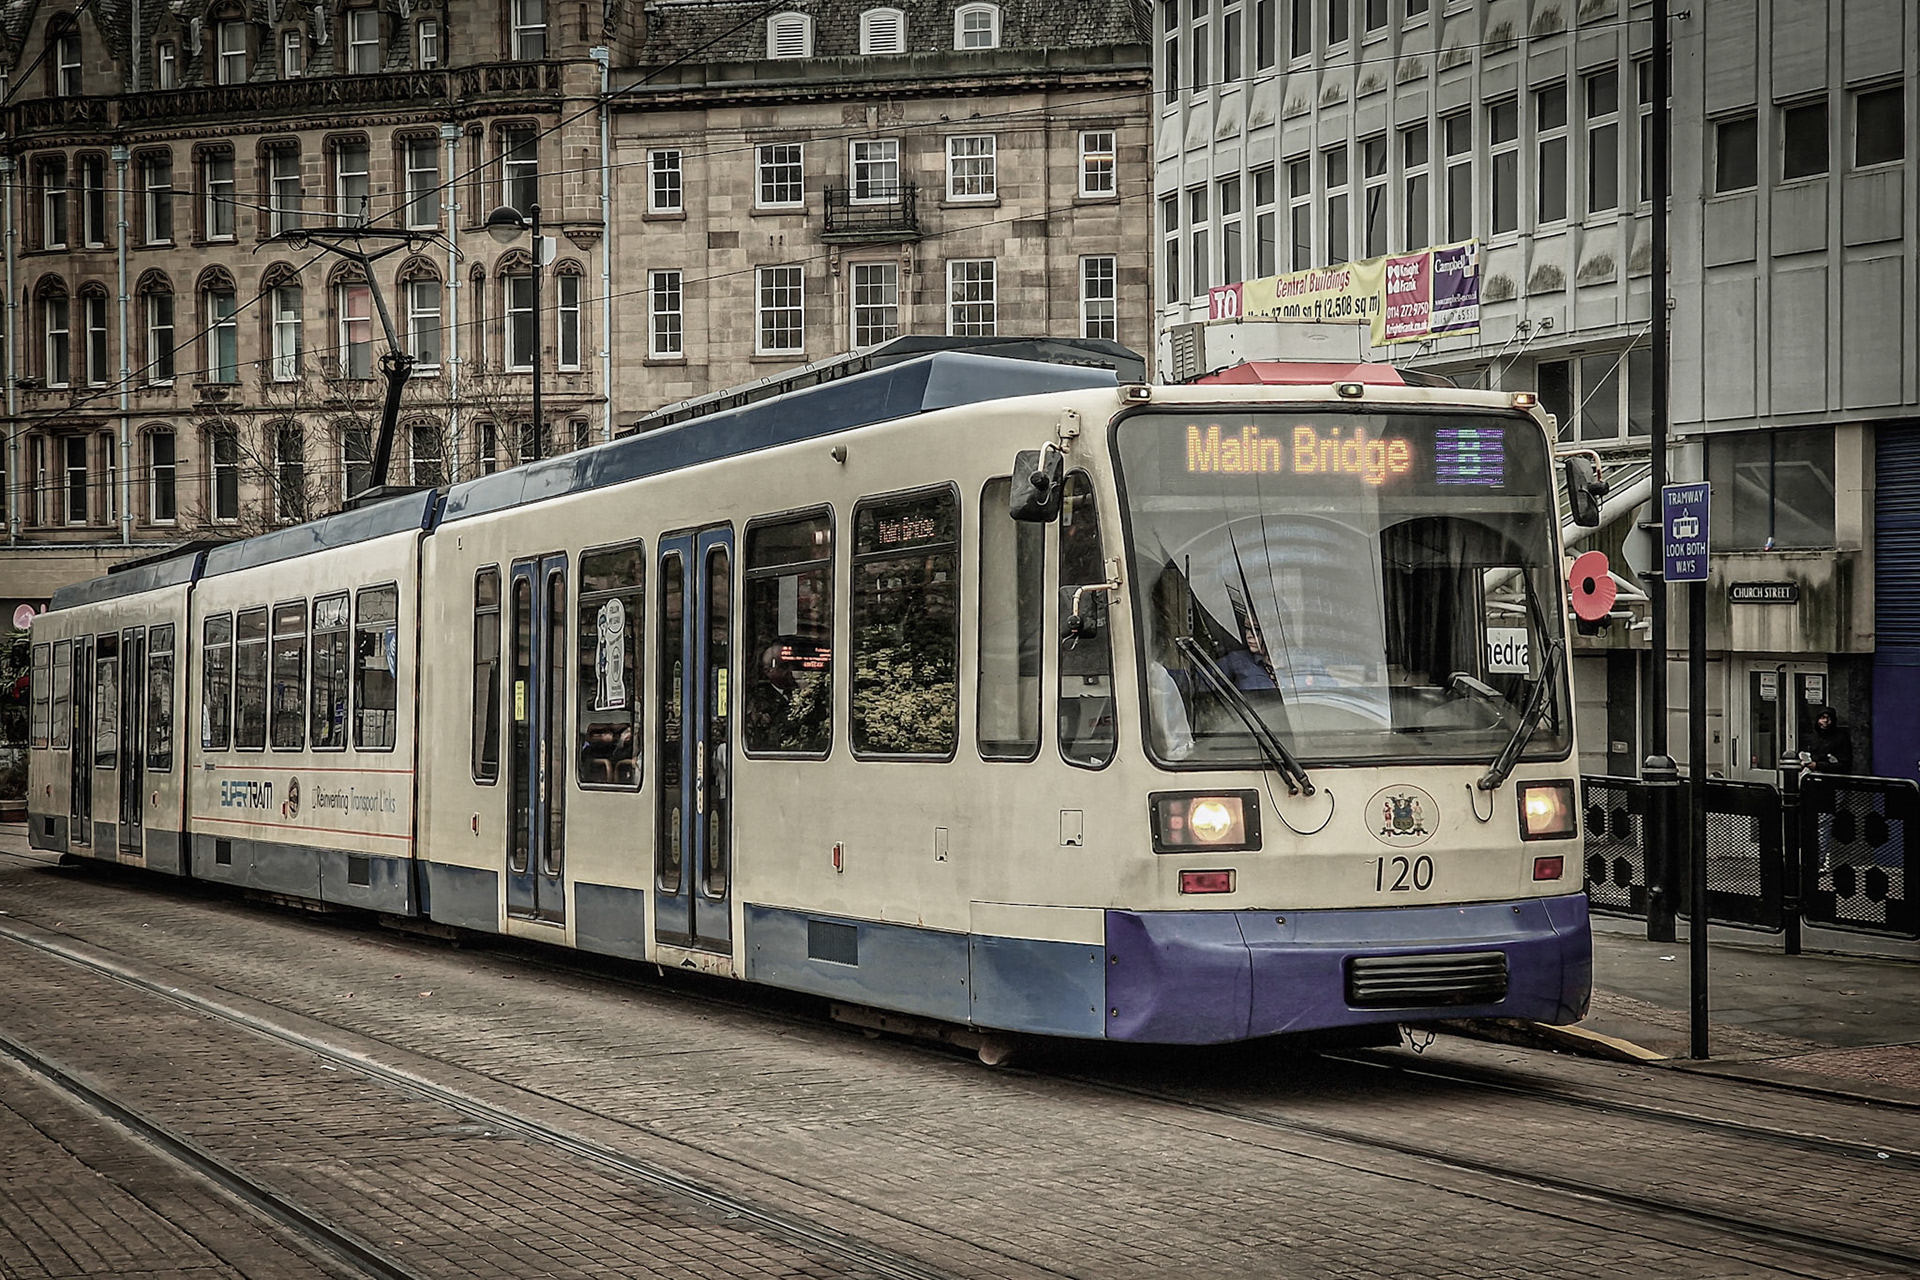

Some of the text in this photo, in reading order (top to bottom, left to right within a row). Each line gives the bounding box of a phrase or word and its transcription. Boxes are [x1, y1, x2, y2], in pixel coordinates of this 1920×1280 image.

[1400, 262, 1419, 278] Knight
[1435, 254, 1465, 275] Campbell
[1276, 269, 1350, 298] Central Buildings
[1400, 279, 1417, 293] Frank
[1213, 289, 1238, 319] TO
[1324, 295, 1352, 318] (2,508
[1354, 297, 1366, 318] sq
[1368, 290, 1380, 315] m)
[1386, 306, 1399, 319] 0114
[1400, 303, 1412, 318] 272
[1186, 425, 1410, 485] Malin Bridge
[1668, 489, 1704, 506] TRAMWAY
[1666, 541, 1706, 558] LOOK BOTH
[1676, 560, 1696, 574] WAYS
[1733, 586, 1790, 599] CHURCH STREET
[350, 786, 378, 816] Transport
[379, 787, 396, 813] Links
[1375, 855, 1434, 892] 120
